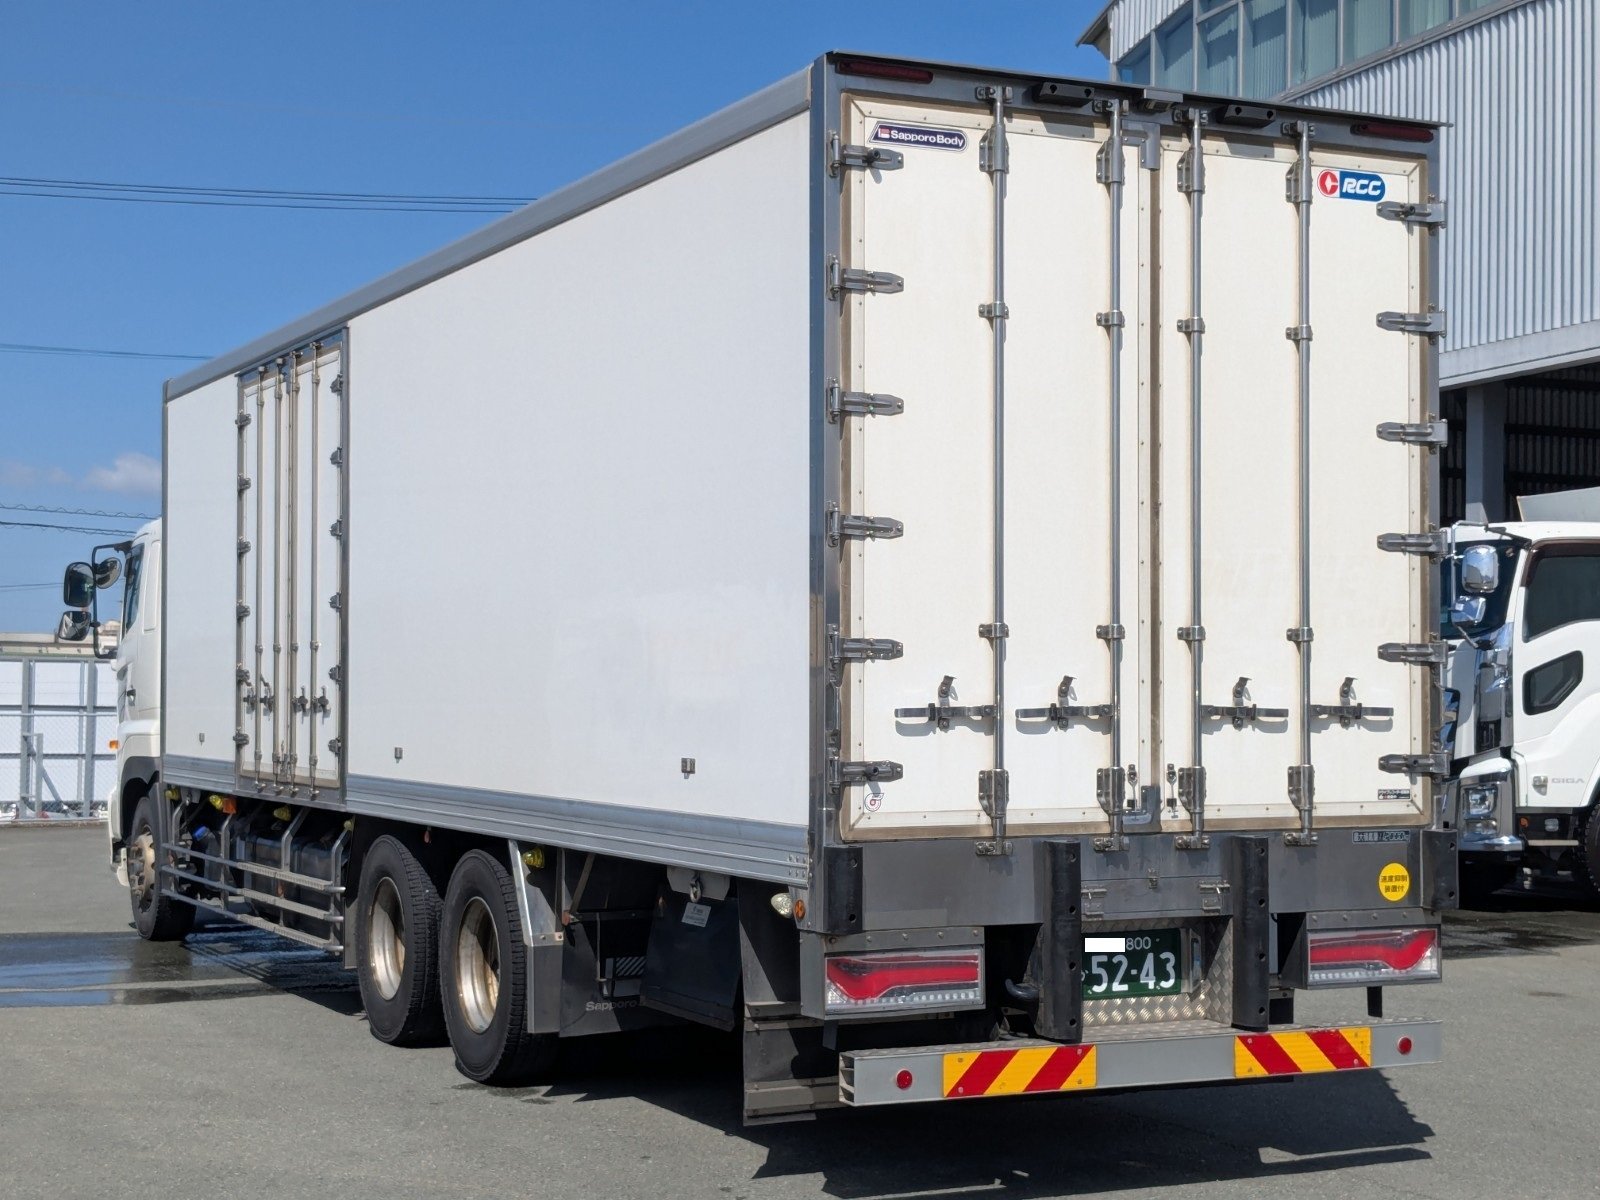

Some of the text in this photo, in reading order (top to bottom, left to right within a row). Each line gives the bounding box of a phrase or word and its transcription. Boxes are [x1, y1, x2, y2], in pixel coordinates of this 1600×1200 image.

[890, 129, 964, 147] Sapporo Body
[1342, 177, 1382, 196] RCC
[1126, 936, 1152, 951] 800
[1091, 951, 1176, 993] 52-43
